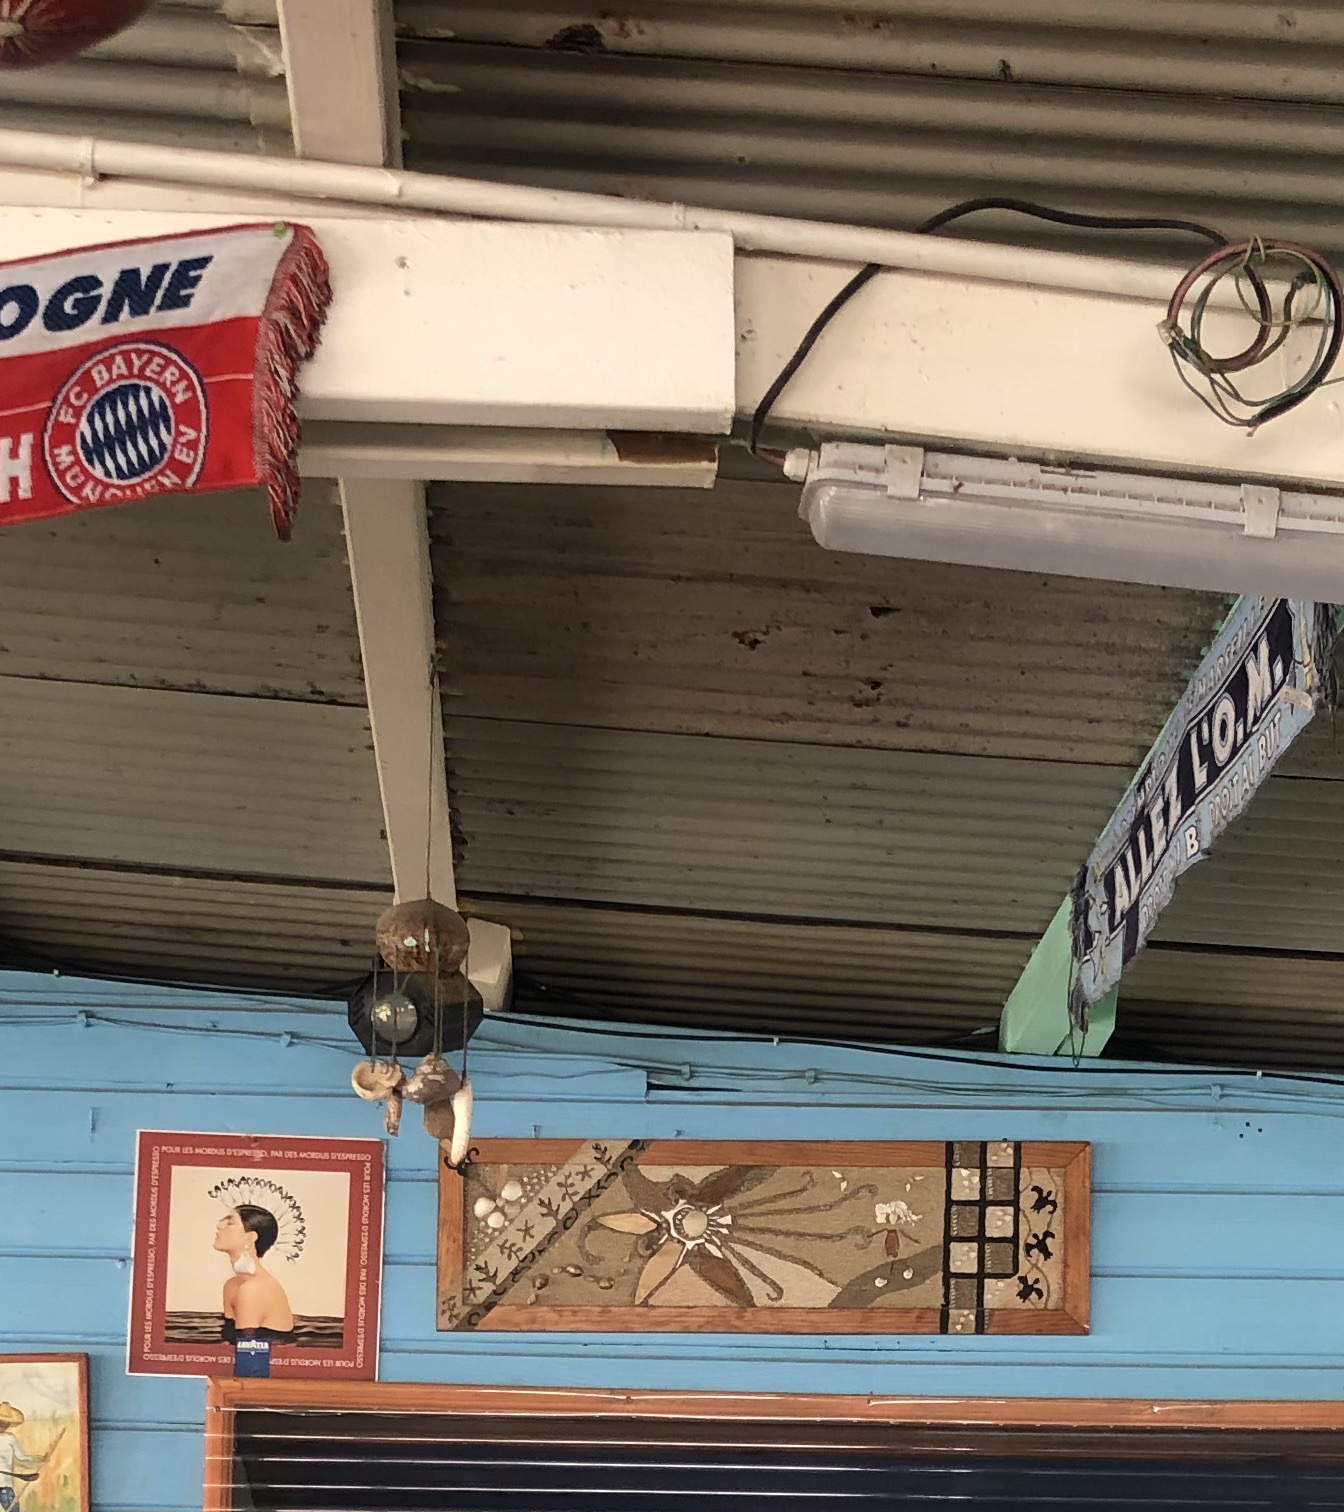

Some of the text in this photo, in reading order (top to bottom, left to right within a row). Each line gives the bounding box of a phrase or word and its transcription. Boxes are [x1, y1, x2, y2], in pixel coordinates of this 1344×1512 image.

[57, 351, 193, 425] FC BAYERN
[1257, 711, 1282, 764] BUT
[1113, 756, 1183, 928] ALLEZ
